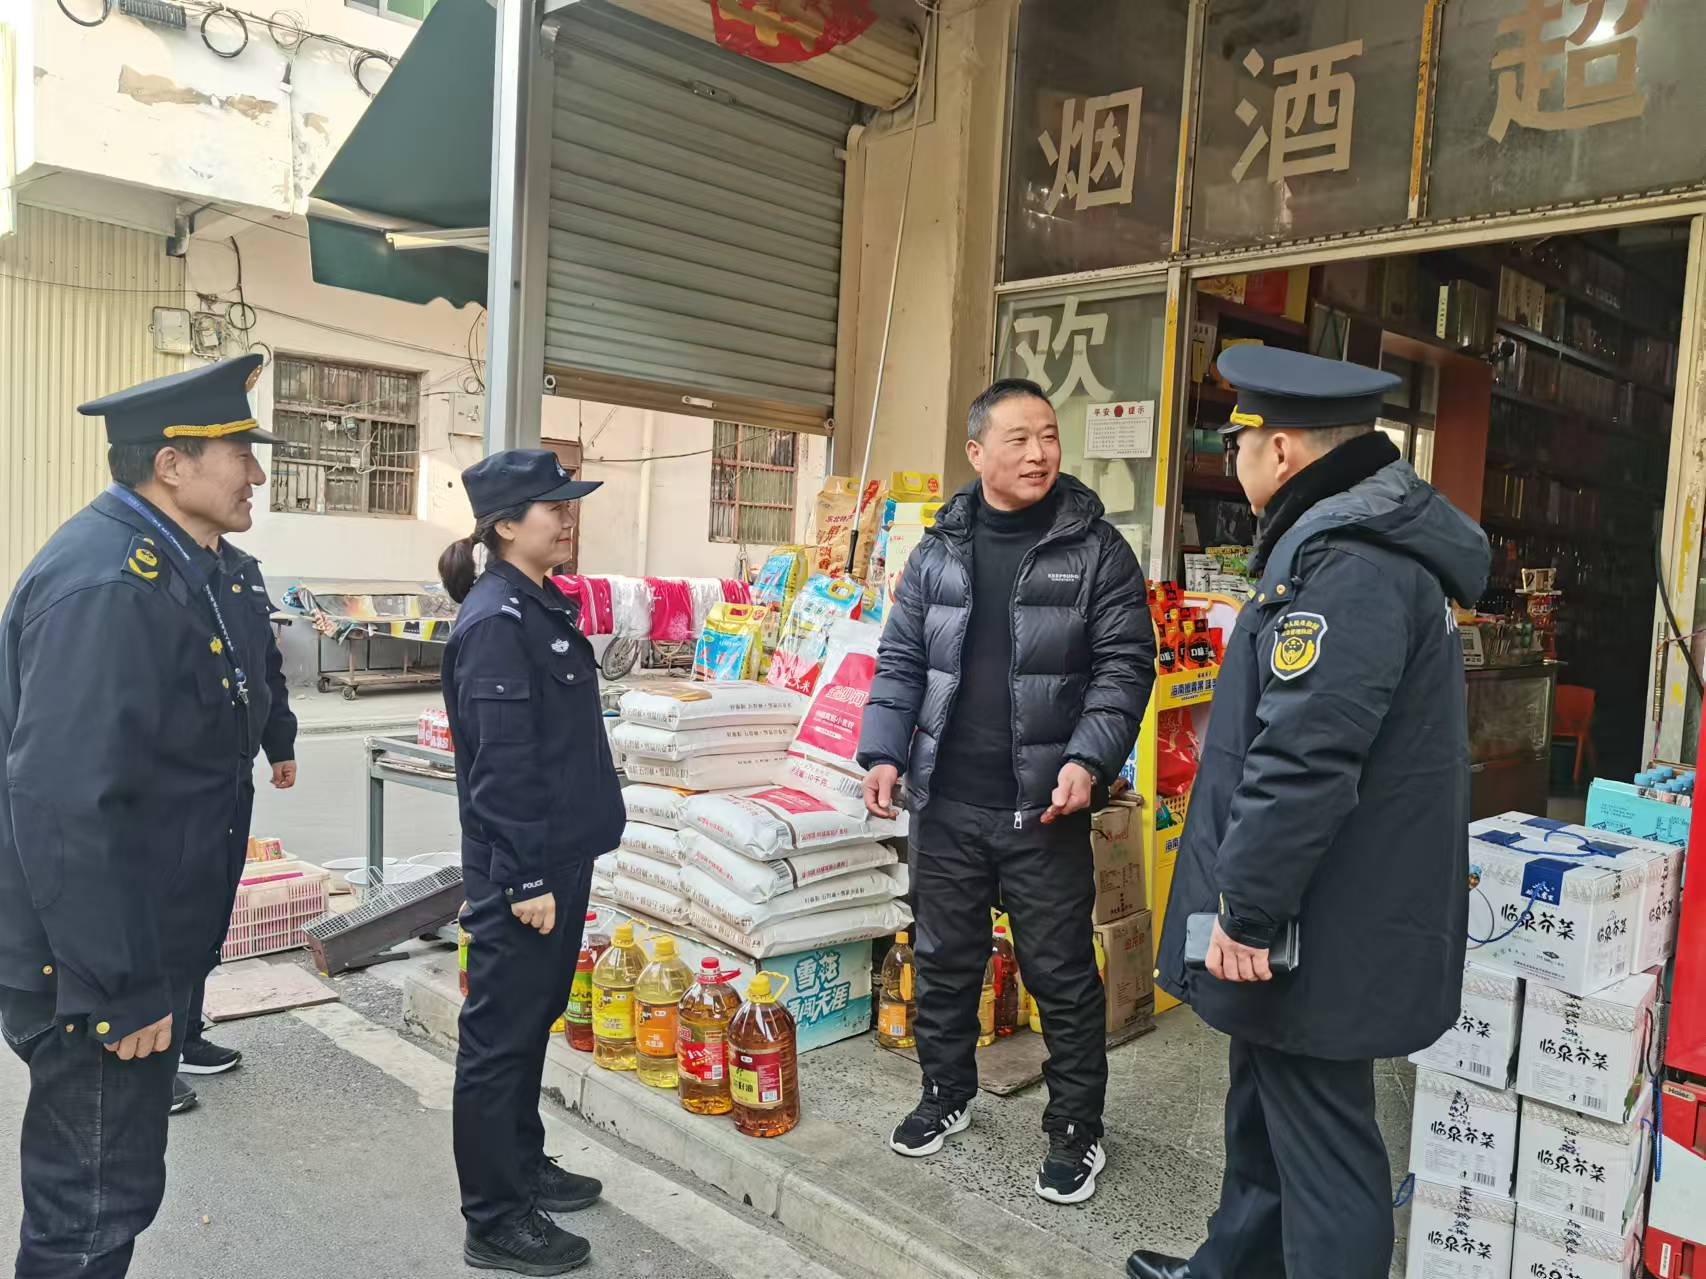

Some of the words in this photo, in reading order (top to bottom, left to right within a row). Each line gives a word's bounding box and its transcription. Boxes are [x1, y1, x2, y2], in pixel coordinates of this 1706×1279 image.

[1013, 295, 1114, 411] 欢
[522, 878, 544, 890] POLICE
[1501, 903, 1576, 941] 临泉芥菜
[796, 951, 841, 992] 雪花
[1450, 1015, 1491, 1038] 芥菜
[1539, 1038, 1609, 1071] 临泉芥菜
[1430, 1120, 1496, 1150] 临泉芥菜
[1537, 1149, 1607, 1183] 临泉芥菜
[1427, 1230, 1493, 1260] 临泉芥菜
